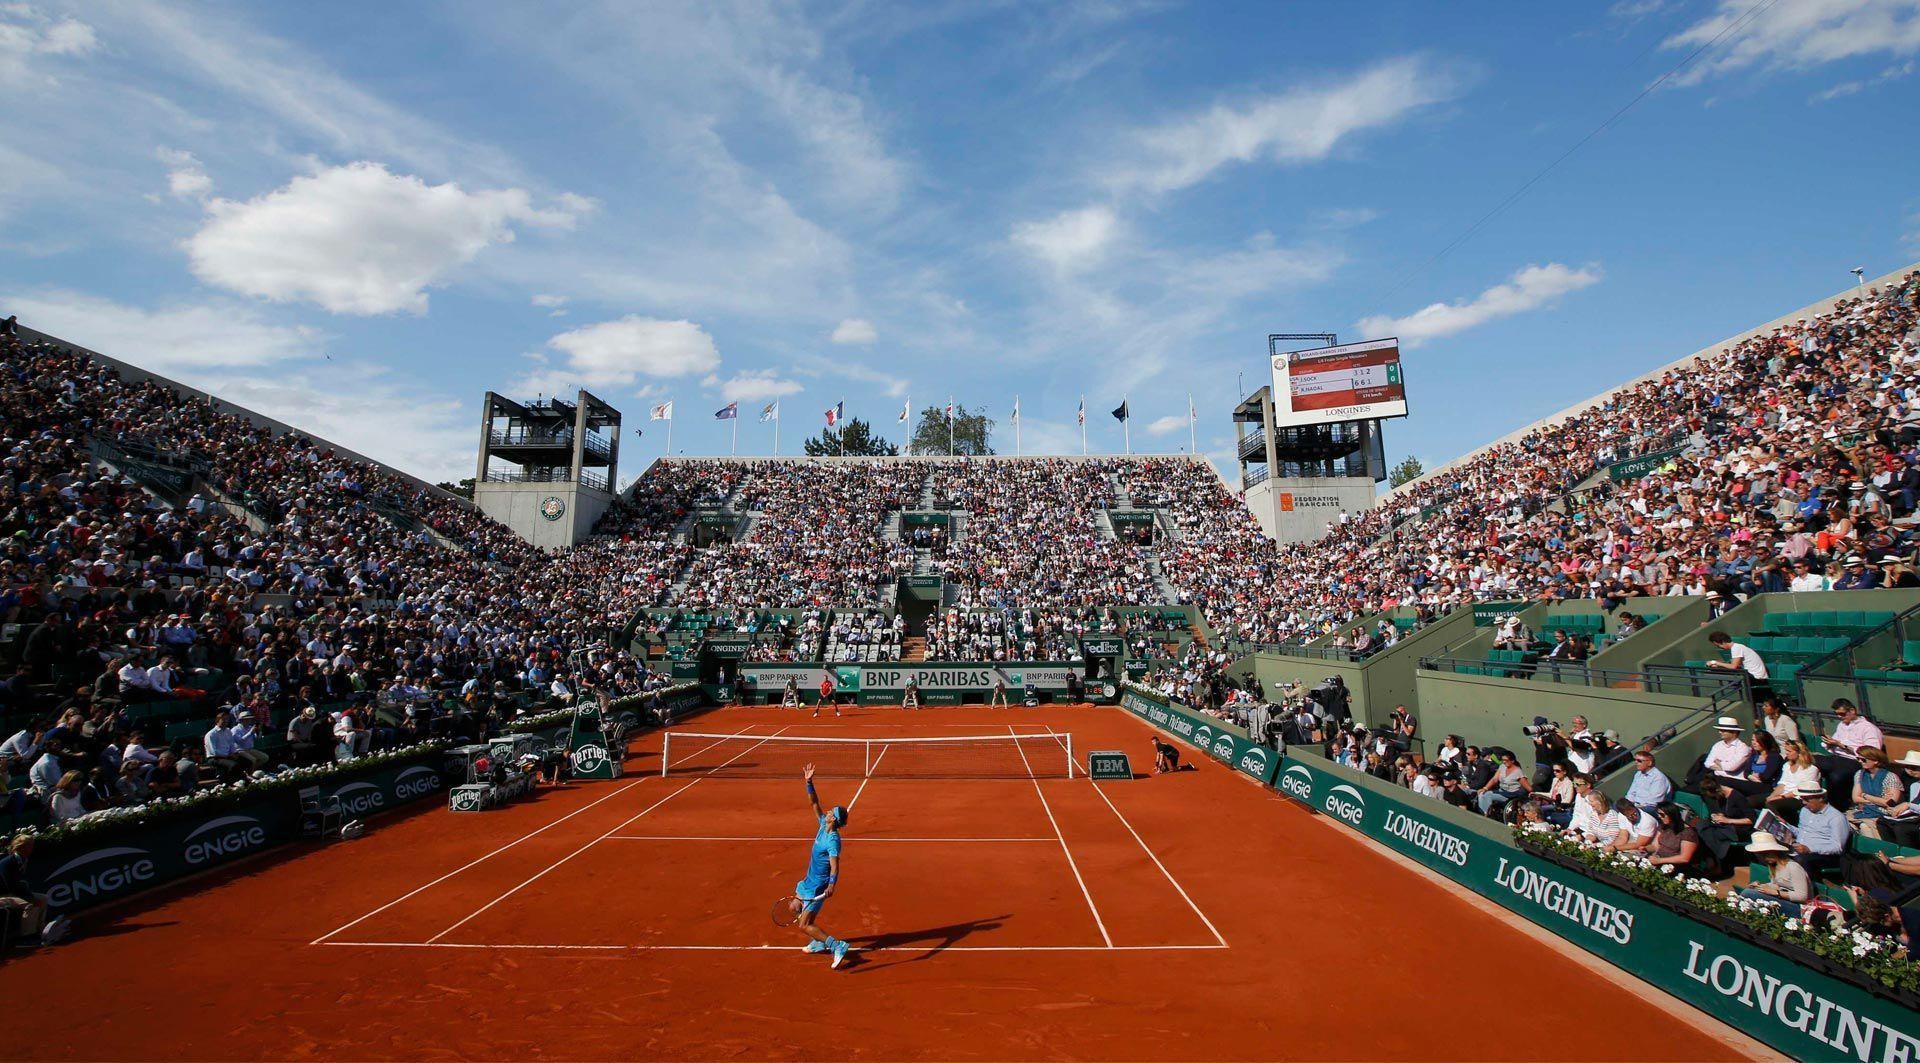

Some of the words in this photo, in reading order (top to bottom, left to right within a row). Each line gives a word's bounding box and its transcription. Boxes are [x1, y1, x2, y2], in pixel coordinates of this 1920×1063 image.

[1325, 405, 1371, 416] LONGINES
[1083, 641, 1119, 654] FedEx
[1125, 661, 1148, 670] FedEx
[760, 673, 775, 681] BNP
[866, 671, 900, 687] BNP
[918, 671, 990, 686] PARIBAS
[1026, 672, 1042, 680] BNP
[1096, 759, 1124, 772] IBM
[1383, 809, 1470, 867] LONGINES
[1494, 857, 1634, 945] LONGINES
[1682, 940, 1920, 1063] LONGINE
